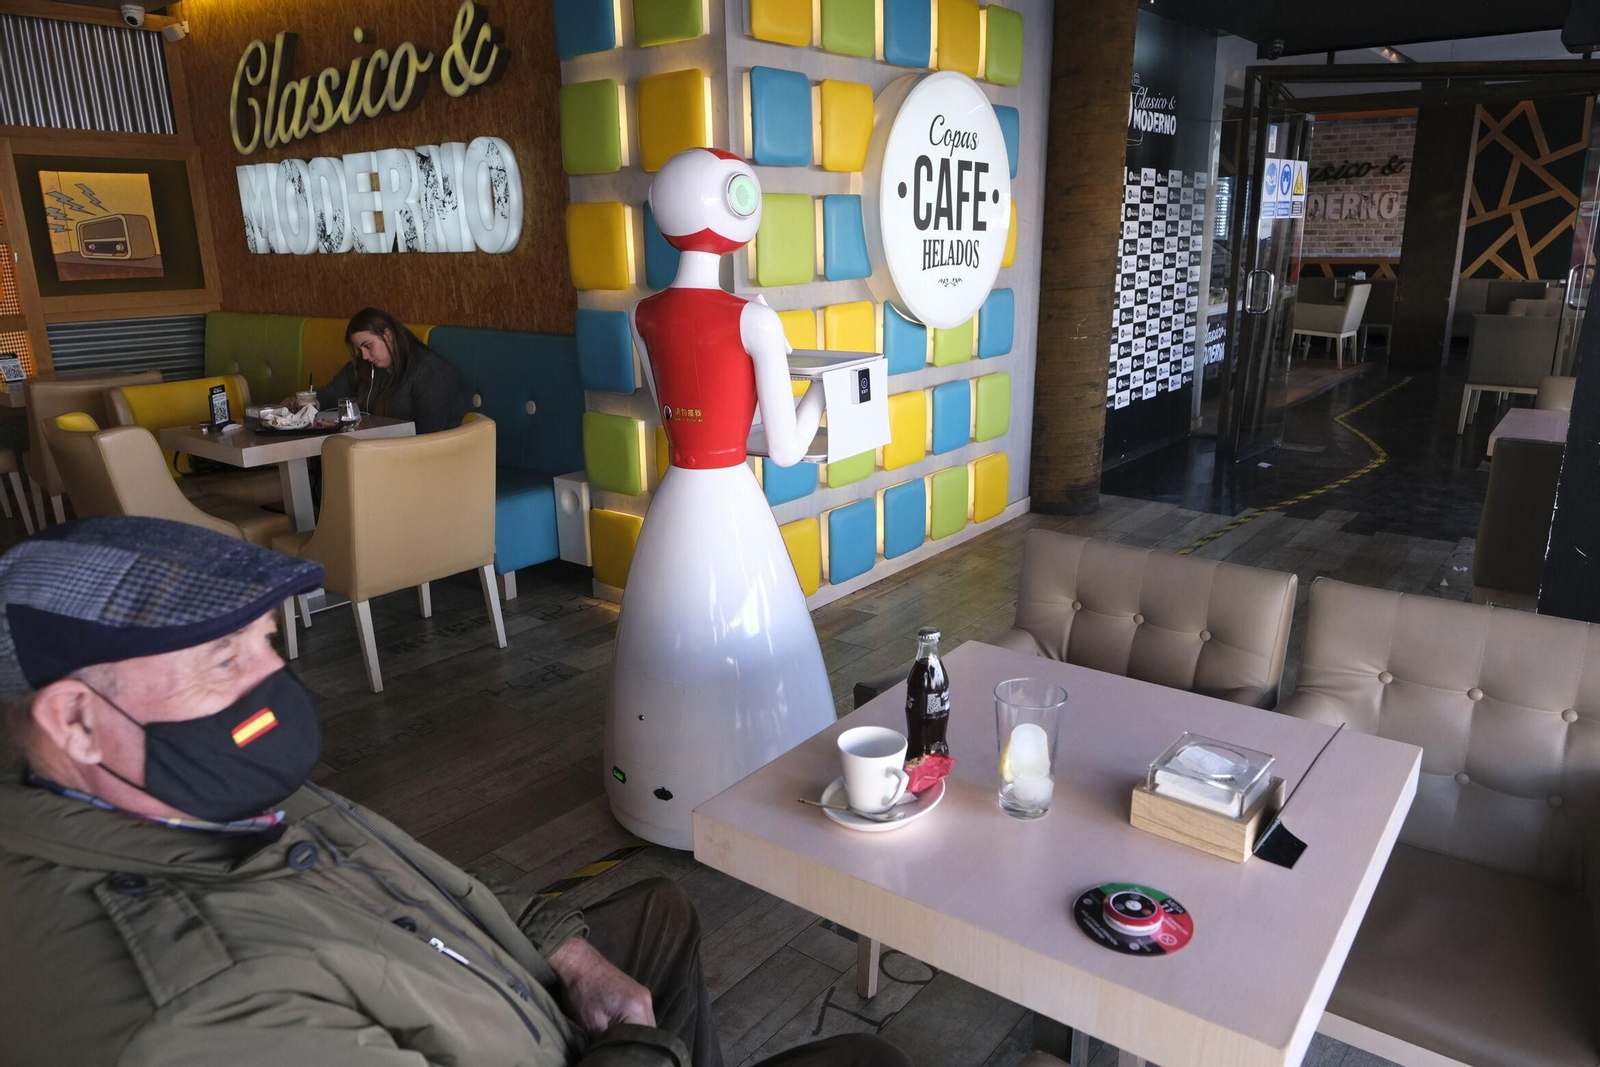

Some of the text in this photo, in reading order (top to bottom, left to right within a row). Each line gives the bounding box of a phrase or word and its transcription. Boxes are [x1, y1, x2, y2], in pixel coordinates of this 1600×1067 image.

[229, 0, 499, 155] Clasico &
[1133, 87, 1176, 111] Clasico &
[929, 114, 979, 157] Copas
[1133, 109, 1177, 135] MODERNO
[1308, 155, 1406, 182] asico &
[234, 136, 524, 255] MODERNO
[914, 155, 989, 231] CAFE
[1306, 191, 1400, 220] DERNO
[922, 239, 979, 271] HELADOS
